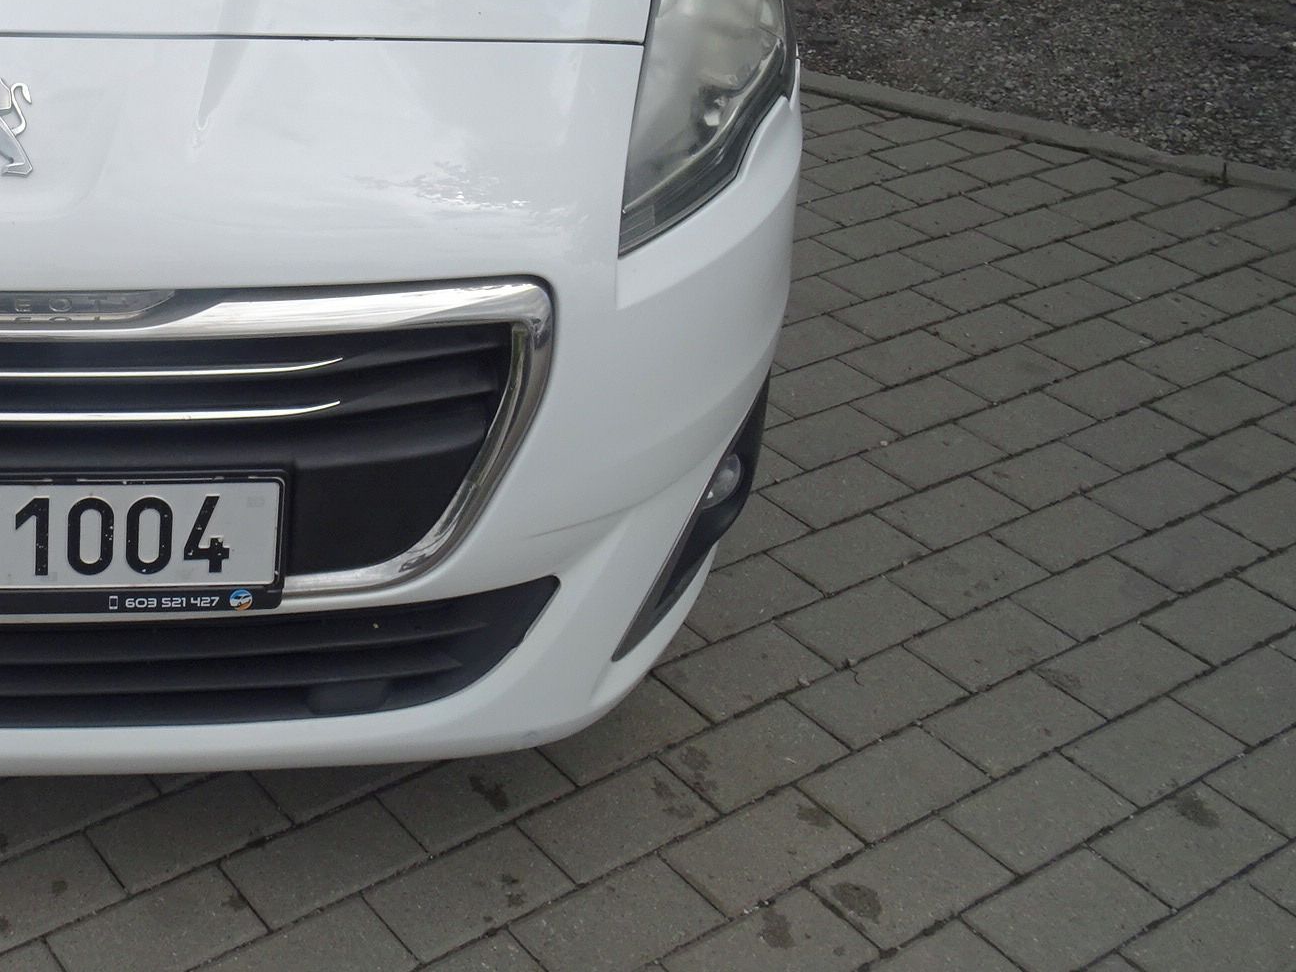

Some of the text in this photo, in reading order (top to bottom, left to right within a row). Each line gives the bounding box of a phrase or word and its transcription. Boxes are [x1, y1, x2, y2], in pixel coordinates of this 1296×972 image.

[14, 495, 230, 577] 1004
[125, 596, 219, 609] 603 521 427
